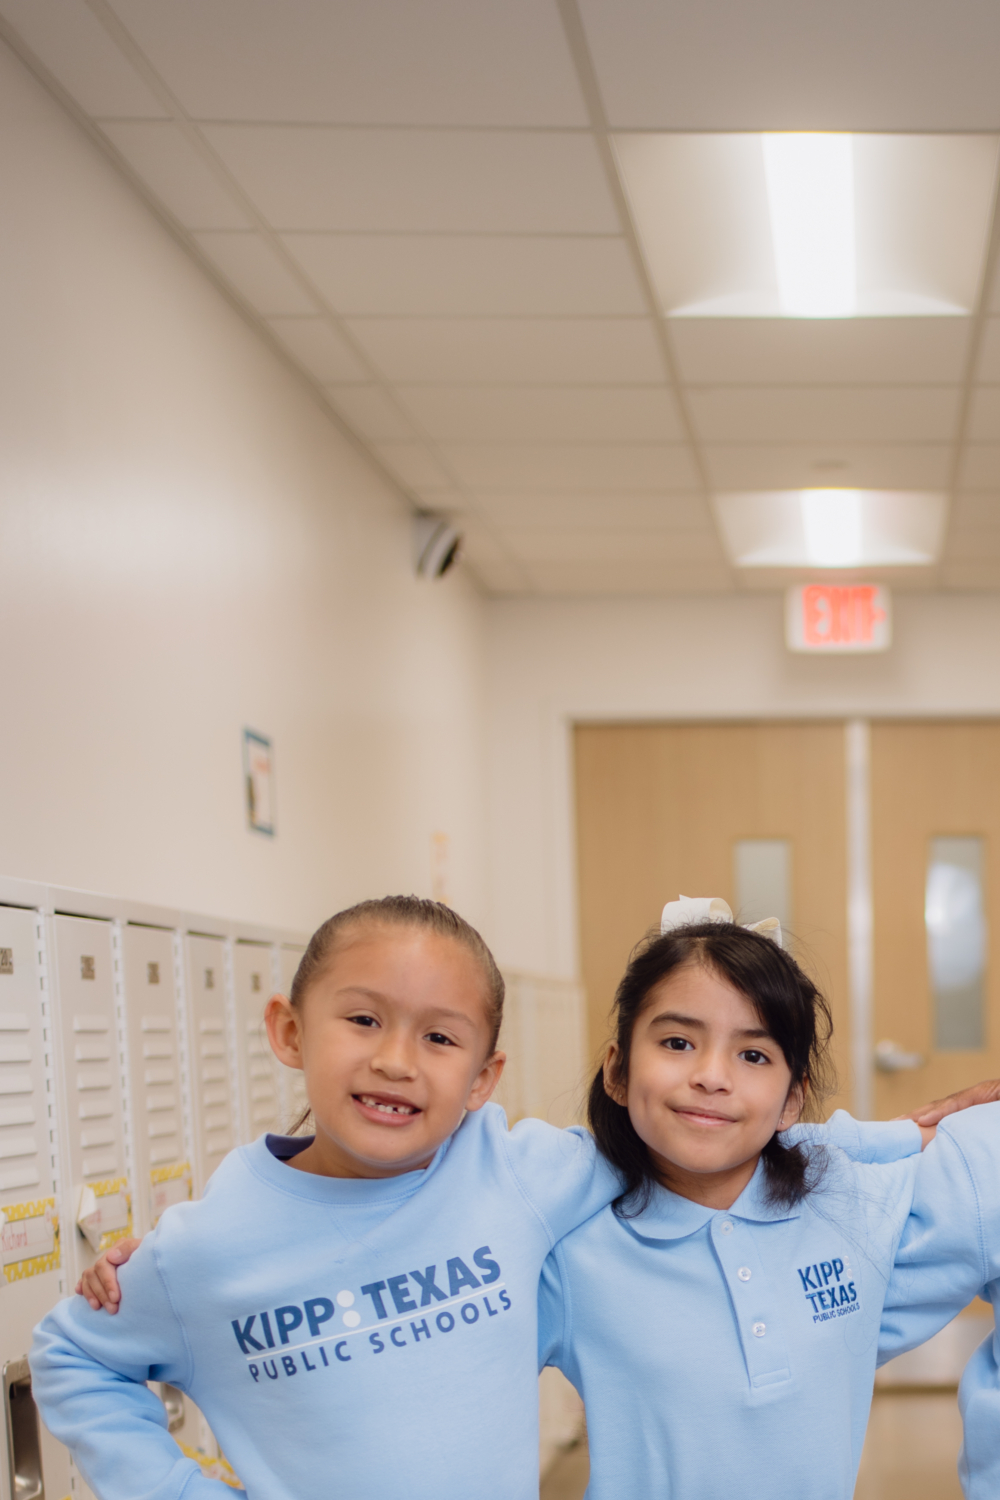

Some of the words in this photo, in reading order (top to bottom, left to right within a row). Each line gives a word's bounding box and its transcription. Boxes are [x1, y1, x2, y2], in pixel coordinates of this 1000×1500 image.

[360, 1245, 502, 1320] TEXAS
[797, 1258, 844, 1292] KIPP
[805, 1281, 857, 1313] TEXAS
[812, 1310, 837, 1324] PUBLIC
[836, 1302, 860, 1317] SCHOOLS
[248, 1341, 352, 1383] PUBLIC
[369, 1289, 512, 1354] SCHOOLS
